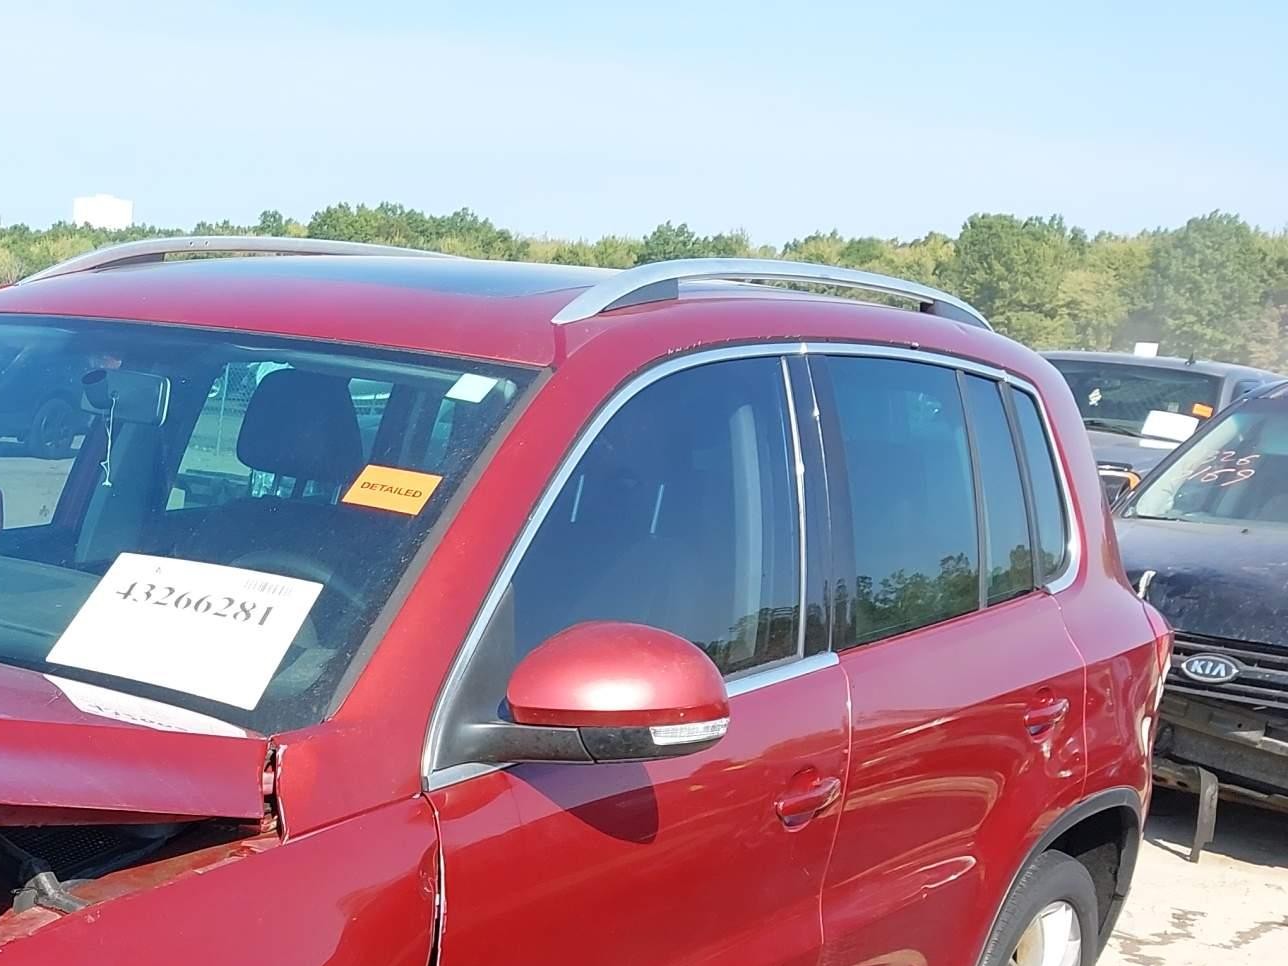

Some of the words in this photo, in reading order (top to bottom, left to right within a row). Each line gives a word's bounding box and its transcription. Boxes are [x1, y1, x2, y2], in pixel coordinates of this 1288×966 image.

[360, 481, 423, 498] DETAILED
[115, 581, 274, 626] 43266281
[1190, 660, 1226, 677] KIA
